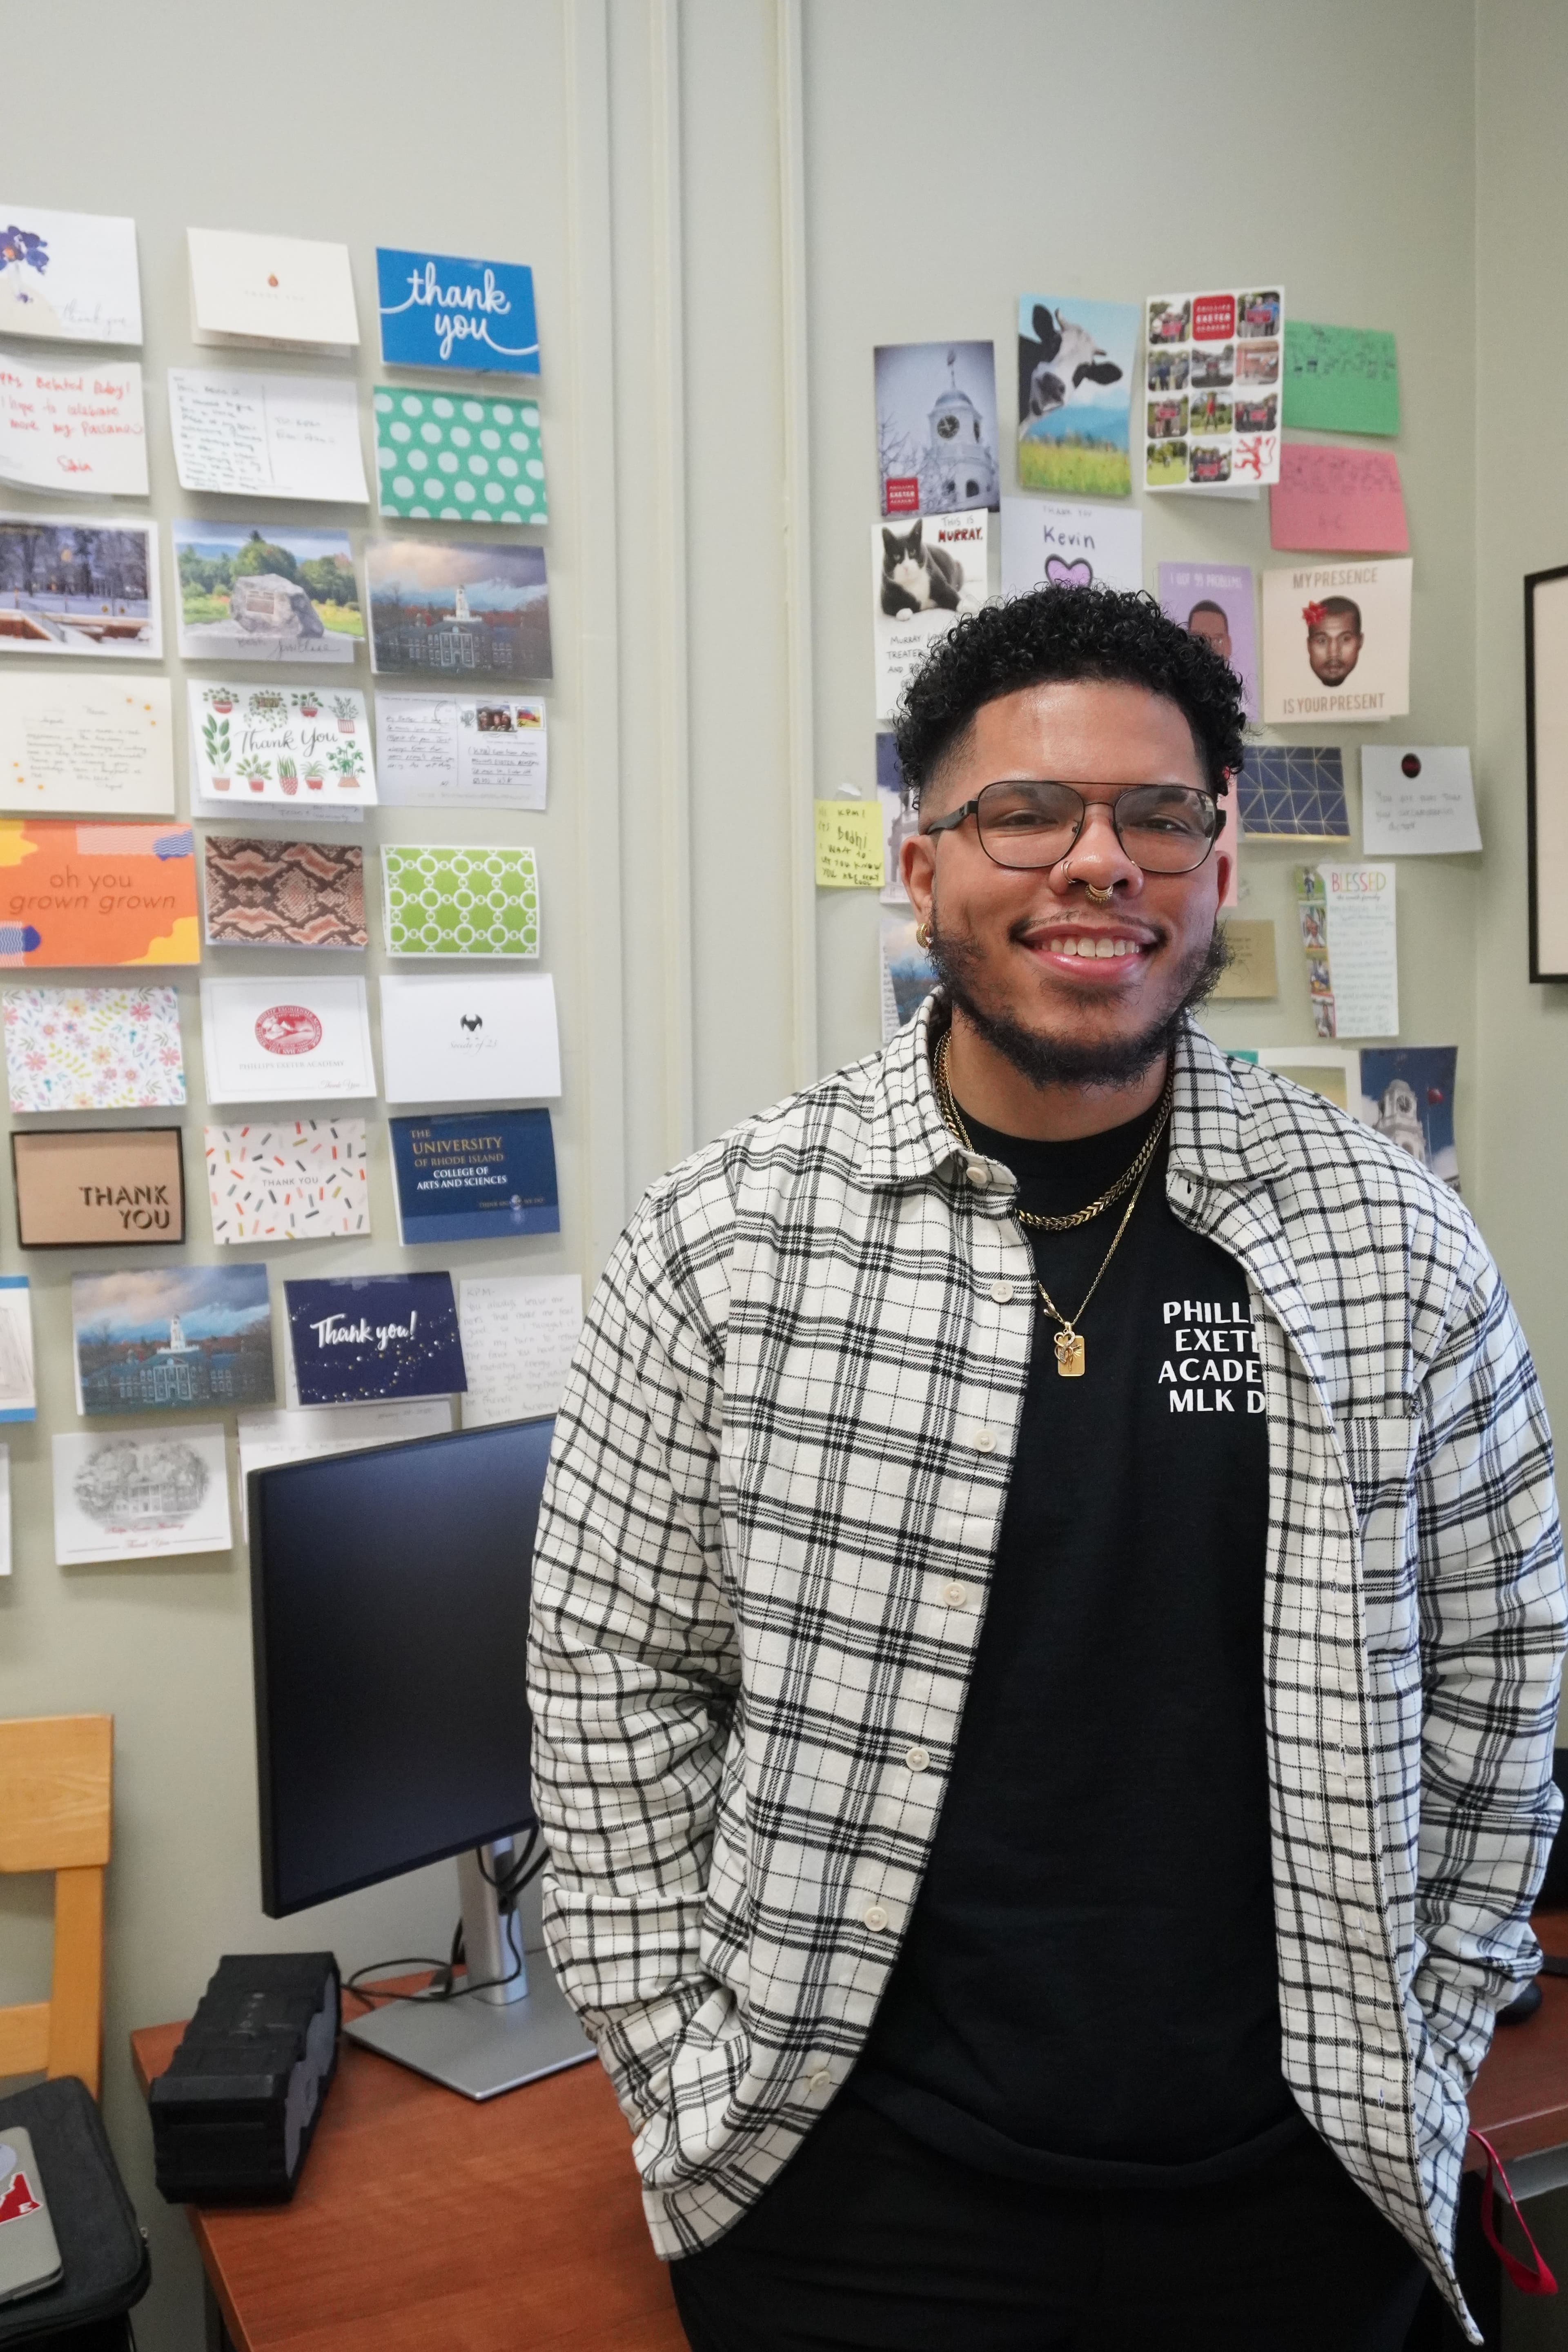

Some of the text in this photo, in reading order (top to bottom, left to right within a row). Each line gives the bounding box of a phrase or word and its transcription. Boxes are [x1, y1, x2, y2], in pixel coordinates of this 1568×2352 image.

[379, 262, 511, 314] thank
[434, 314, 519, 360] you
[1044, 524, 1096, 549] Kevin
[1292, 567, 1378, 589] MY PRESENCE
[1283, 692, 1385, 714] IS YOUR PRESENT
[234, 727, 338, 757] Thank You
[50, 864, 131, 892] oh you
[1332, 871, 1387, 893] BLESSED
[9, 895, 175, 915] grown grown
[307, 1060, 344, 1068] ACADEMY
[410, 1129, 431, 1139] THE
[412, 1136, 502, 1154] UNIVERSITY
[414, 1153, 505, 1167] OF RHODE ISLAND
[263, 1178, 295, 1186] THANK
[416, 1174, 508, 1190] ARTS AND SCIENCES
[433, 1166, 489, 1179] COLLEGE OF
[78, 1185, 171, 1230] THANK YOU
[310, 1310, 417, 1351] Thank you!
[1158, 1358, 1262, 1384] ACADE
[1169, 1389, 1266, 1413] MLK D
